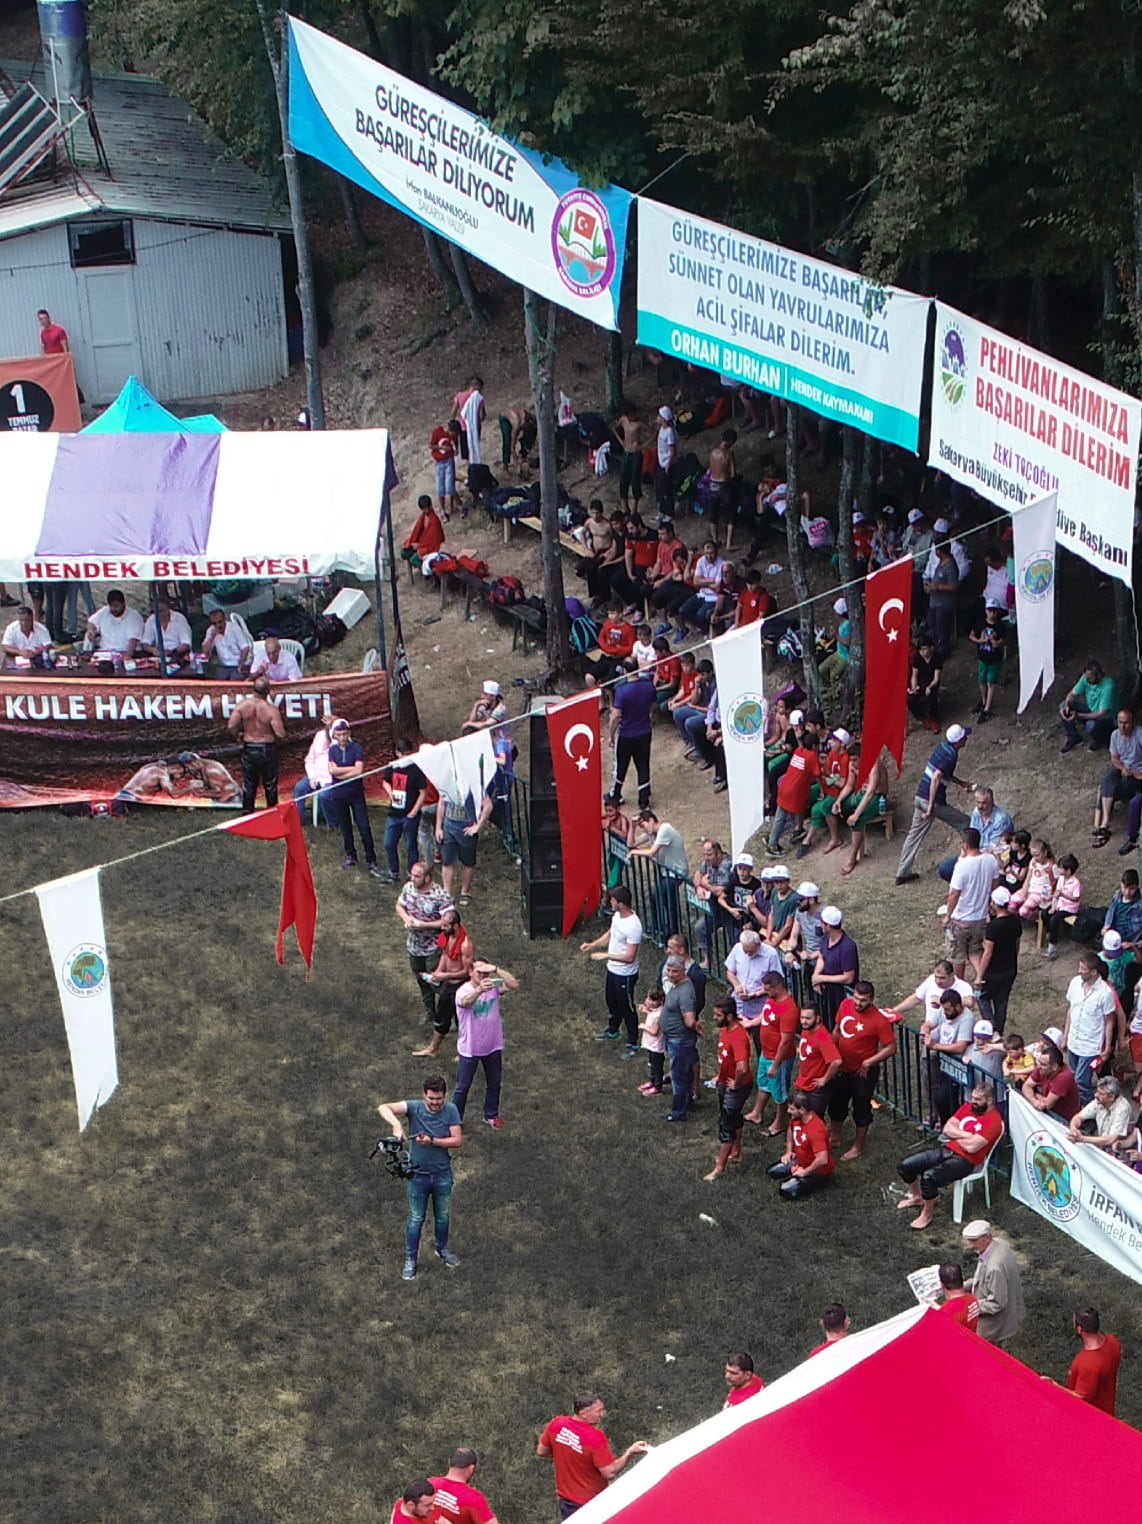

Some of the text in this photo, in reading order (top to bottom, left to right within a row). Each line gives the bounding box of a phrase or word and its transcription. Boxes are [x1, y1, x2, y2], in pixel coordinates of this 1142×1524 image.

[375, 84, 518, 183] GÜREŞÇİLERİMİZE
[355, 108, 438, 178] BAŞARILAR
[443, 157, 535, 233] DİLİYORUM
[672, 220, 797, 282] GÜREŞÇİLERİMİZE
[668, 250, 890, 353] SÜNNET OLAN YAVRULARIMIZA
[670, 329, 719, 367] ORHAN
[722, 349, 781, 390] BURHAN
[696, 296, 856, 376] ACİL ŞİFALAR DİLERİM.
[10, 383, 26, 414] 1
[979, 335, 1129, 445] PEHLİVANLARIMIZA
[938, 438, 976, 477] Sakarya
[975, 375, 1131, 490] BAŞARILAR DİLERİM
[992, 441, 1013, 469] ZEKİ
[24, 555, 310, 580] HENDEK BELEDİYESİ
[1079, 520, 1128, 568] Başkanı
[5, 694, 88, 721] KULE
[95, 693, 213, 721] HAKEM
[1087, 1210, 1127, 1242] Hendek
[1088, 1184, 1135, 1229] İRFAN
